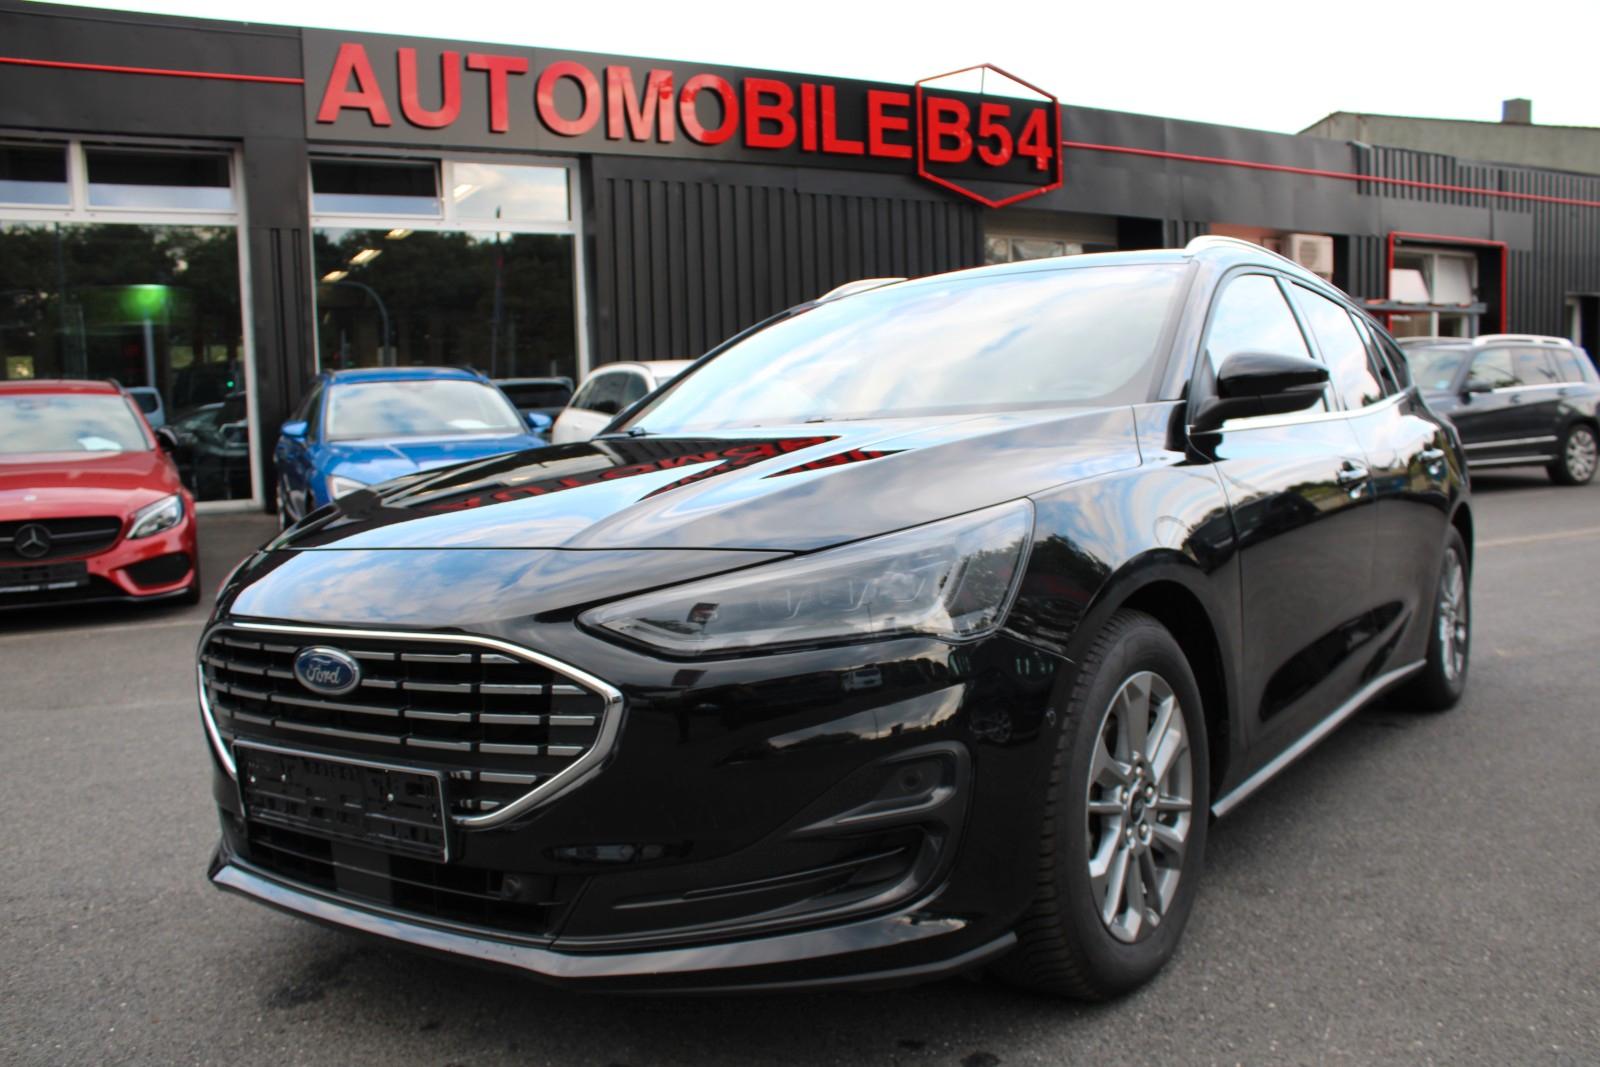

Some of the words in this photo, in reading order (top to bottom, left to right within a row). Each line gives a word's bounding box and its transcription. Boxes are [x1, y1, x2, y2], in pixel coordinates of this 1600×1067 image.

[316, 42, 912, 159] AUTOMOBILE
[926, 97, 1052, 171] B54
[306, 657, 341, 684] Ford
